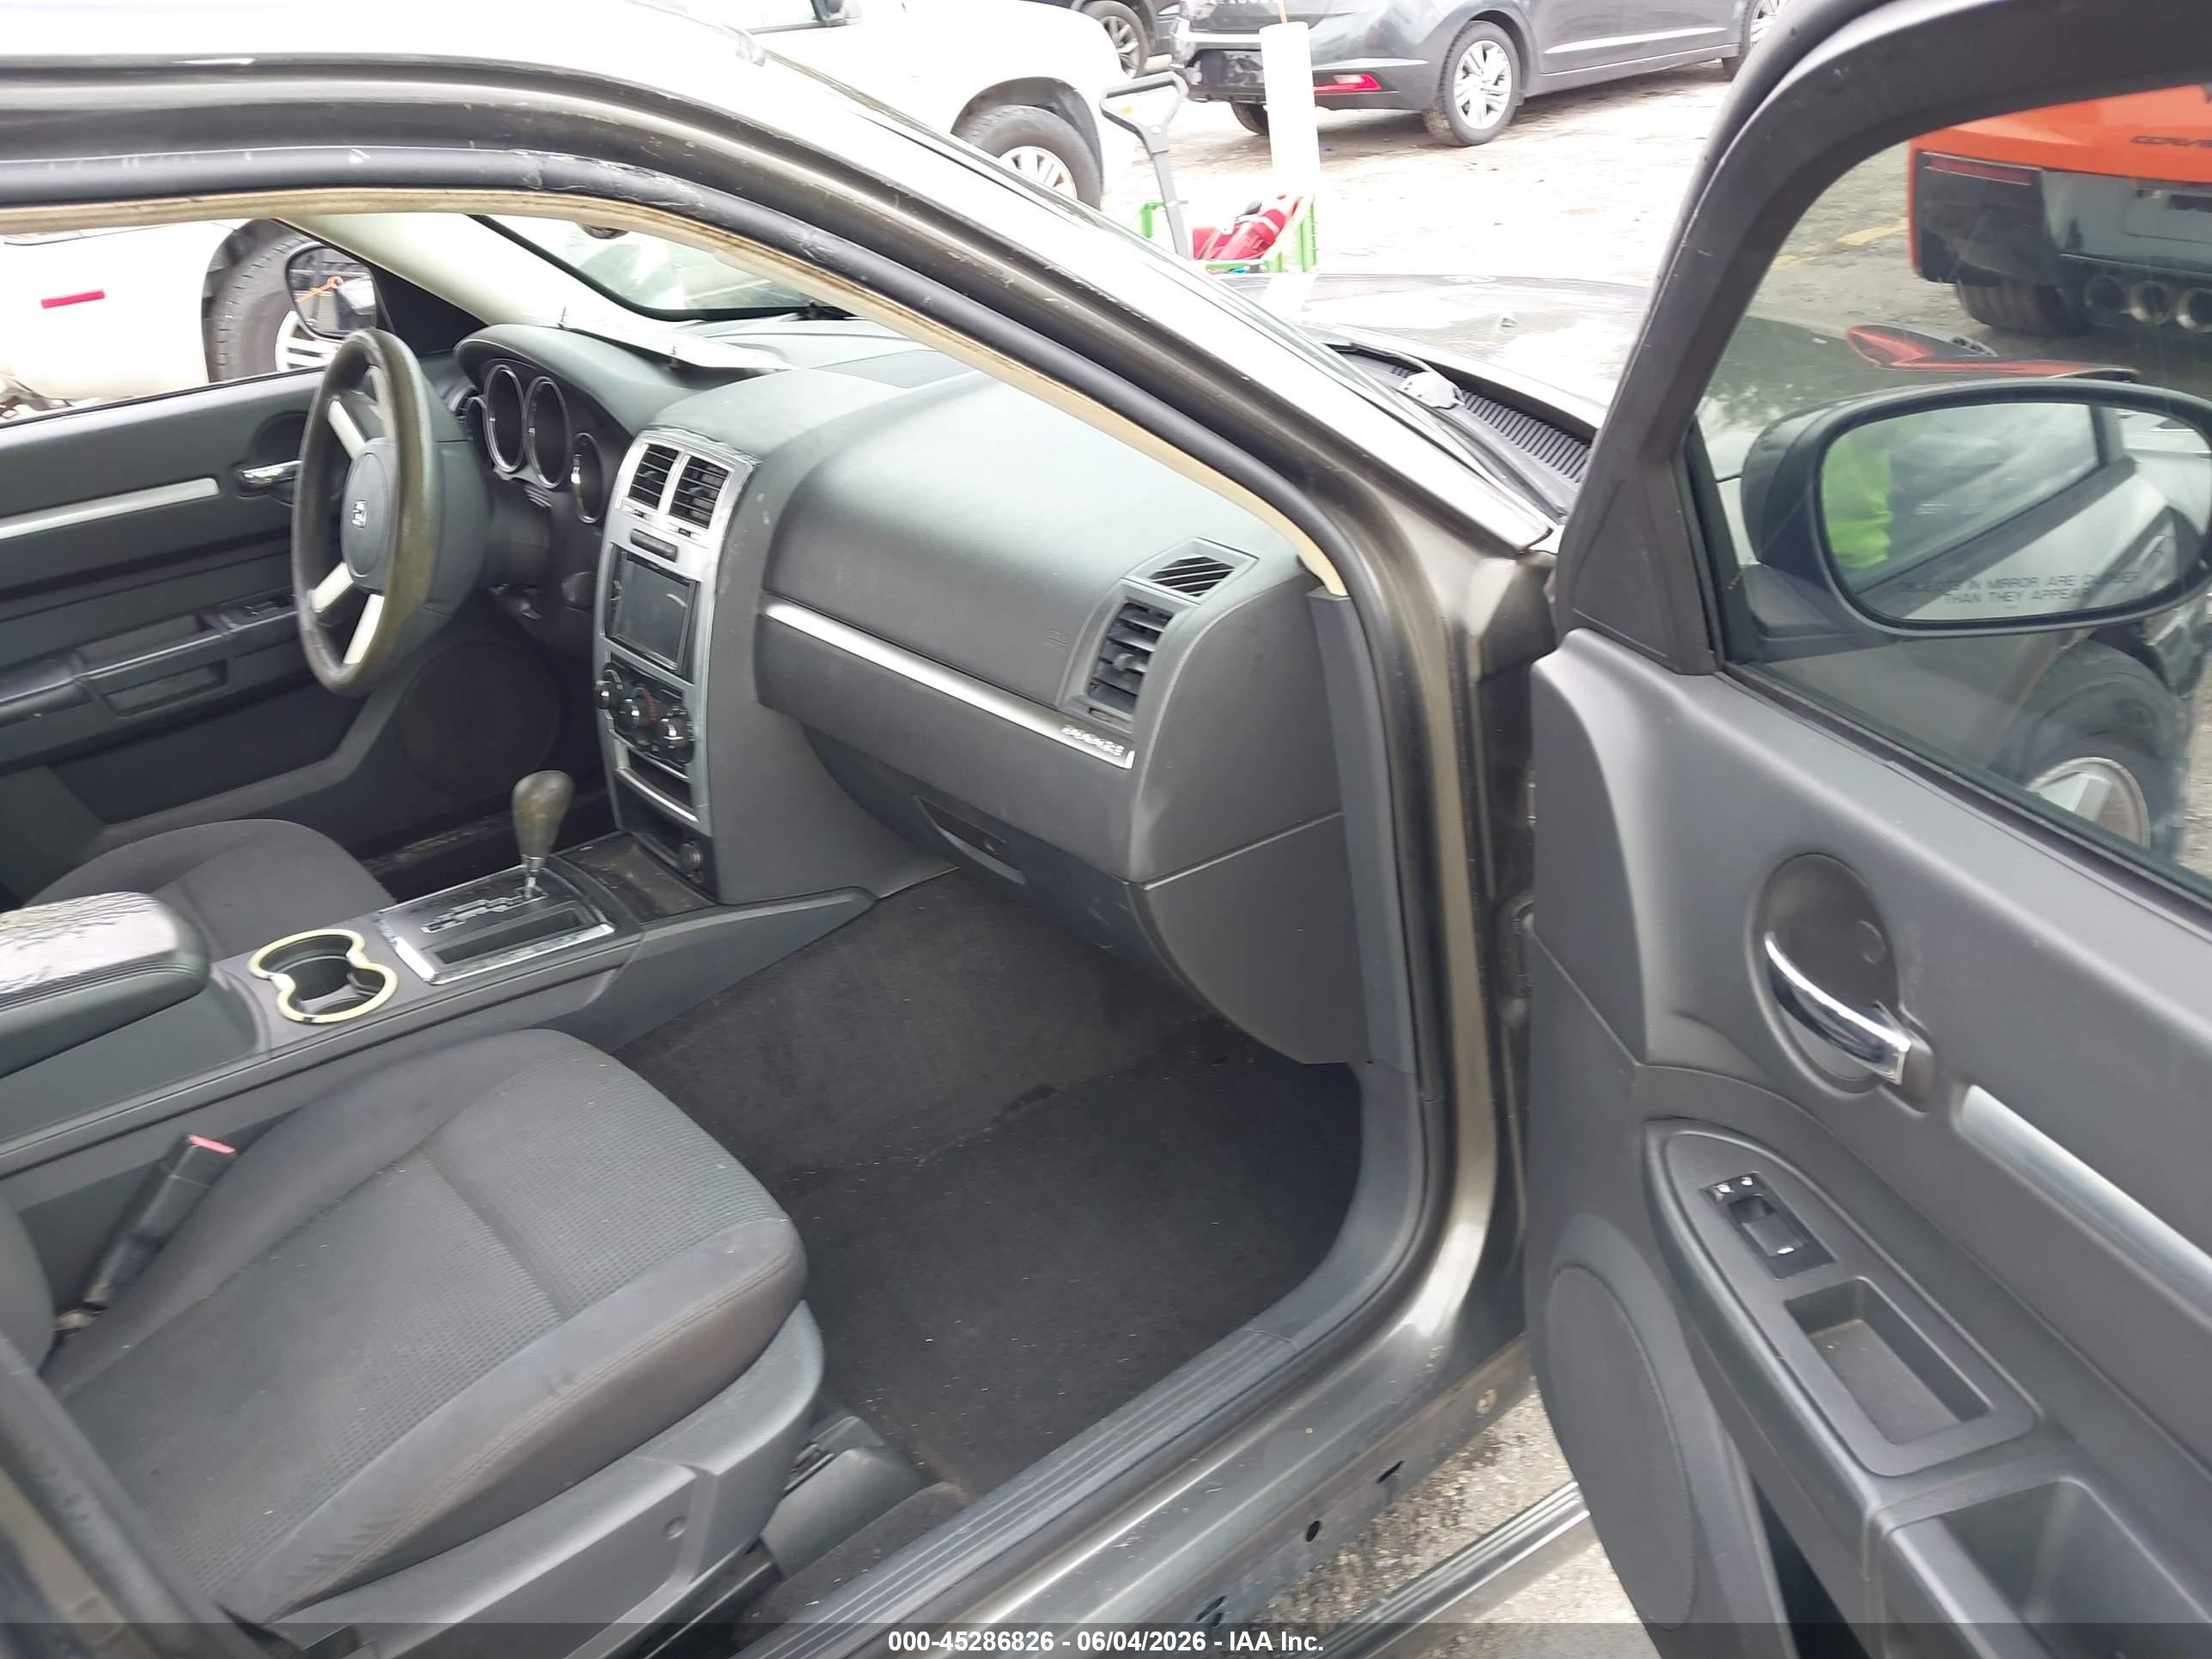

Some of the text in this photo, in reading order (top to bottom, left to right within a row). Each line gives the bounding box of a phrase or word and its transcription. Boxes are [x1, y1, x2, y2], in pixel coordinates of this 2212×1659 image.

[1969, 580, 1981, 590] IN
[1987, 577, 2039, 589] MIRROR
[2047, 574, 2075, 586] ARE
[1943, 592, 1982, 605] THAN
[1988, 591, 2024, 603] THEY
